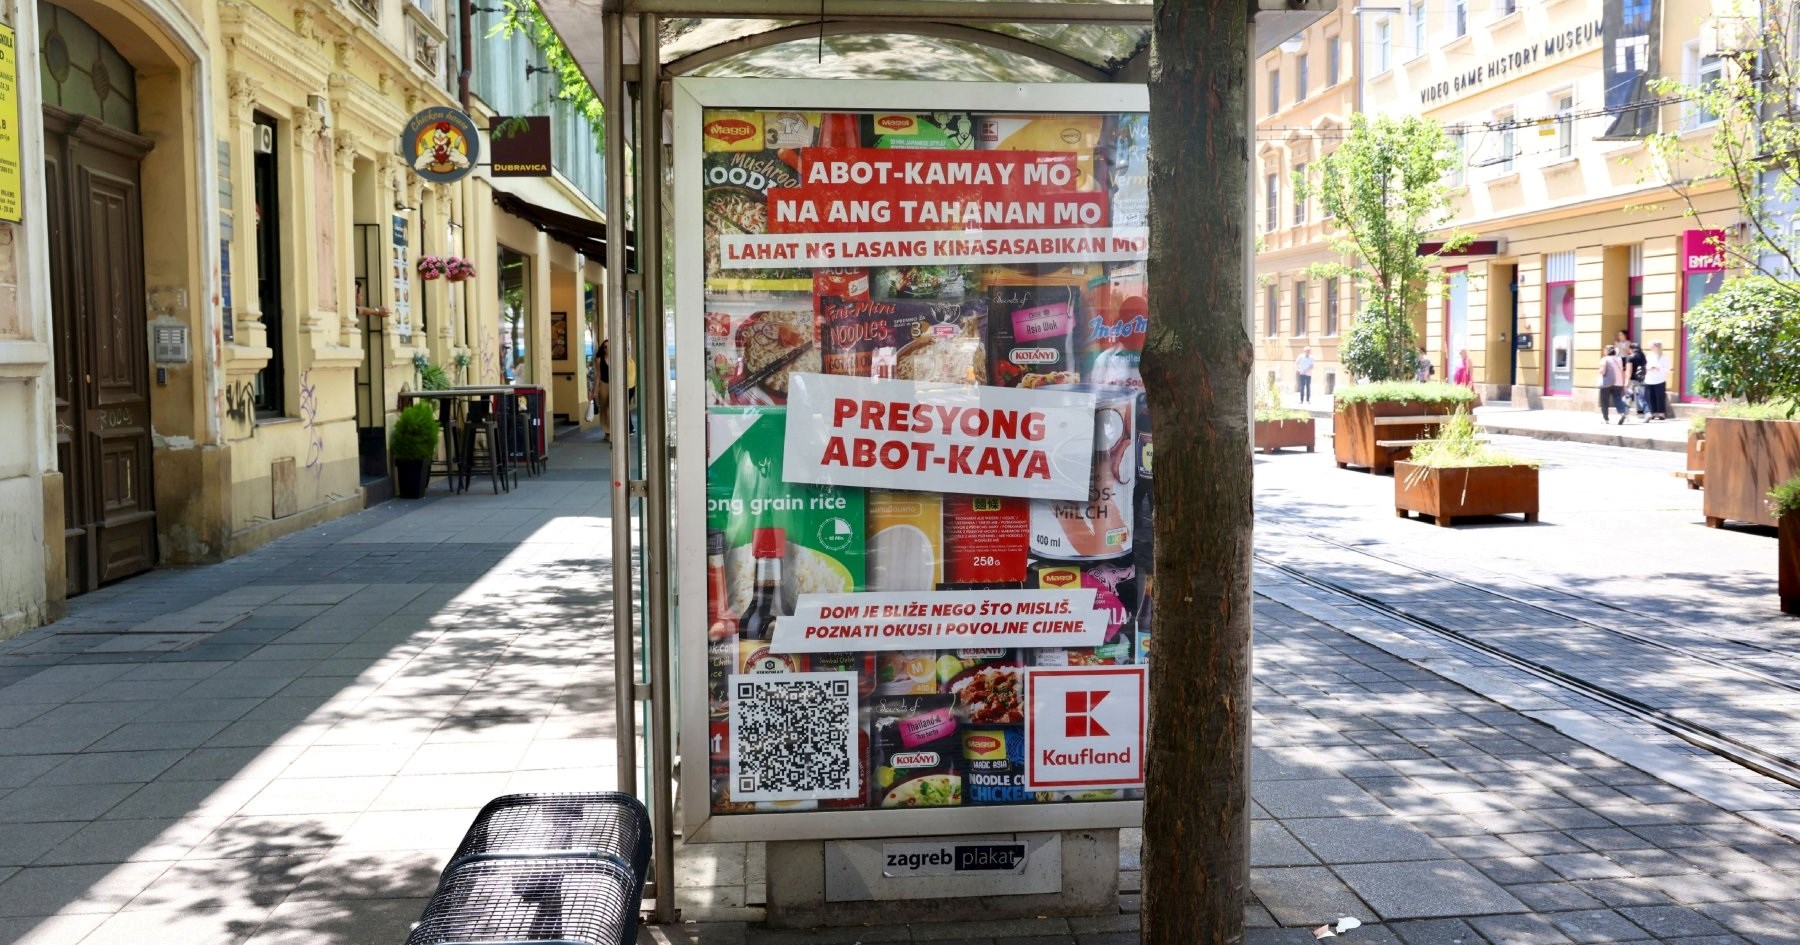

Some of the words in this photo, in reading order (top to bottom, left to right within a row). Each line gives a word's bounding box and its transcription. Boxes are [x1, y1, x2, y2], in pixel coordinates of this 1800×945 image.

[1421, 82, 1449, 104] VIDEO
[1454, 66, 1483, 92] GAME
[1488, 44, 1539, 79] HISTORY
[1545, 20, 1604, 57] MUSEUM
[411, 109, 444, 131] Chicken
[881, 118, 910, 127] Maggi
[710, 124, 751, 136] Maggi
[767, 128, 779, 145] 3
[494, 164, 547, 172] DUBRAVICA
[808, 161, 1015, 185] ABOT-KAMAY
[1024, 163, 1071, 186] MO
[704, 166, 778, 196] OOD
[777, 200, 819, 222] NA
[828, 200, 891, 223] ANG
[900, 201, 1045, 225] TAHANAN
[1054, 202, 1102, 225] MO
[728, 243, 799, 260] LAHAT
[806, 242, 836, 259] NG
[842, 240, 927, 258] LASANG
[933, 236, 1106, 257] KINASASABIKAN
[1113, 236, 1147, 253] MO
[911, 321, 922, 337] 3
[1026, 323, 1042, 335] Asia
[1043, 320, 1058, 332] Wok
[1015, 347, 1054, 360] KOTÁNYI
[833, 398, 1046, 441] PRESYONG
[821, 436, 1051, 480] ABOT-KAYA
[751, 494, 804, 515] grain
[810, 494, 847, 509] rice
[1055, 503, 1108, 520] MILCH
[1036, 534, 1049, 547] 400
[1050, 536, 1061, 548] ml
[1046, 573, 1073, 582] Maggi
[820, 605, 859, 619] DOM
[863, 605, 879, 618] JE
[883, 601, 928, 617] BLIŽE
[931, 602, 976, 616] NEGO
[980, 600, 1012, 616] ŠTO
[1016, 598, 1072, 615] MISLIŠ.
[805, 624, 879, 639] POZNATI
[883, 623, 931, 637] OKUSI
[936, 623, 942, 636] I
[945, 621, 1028, 635] POVOLJNE
[1032, 620, 1086, 634] CIJENE.
[911, 663, 923, 674] M
[907, 715, 935, 732] Thailand
[967, 740, 995, 749] Maggi
[896, 751, 935, 765] KOTÁNYI
[973, 761, 991, 769] MAGIC
[992, 760, 1007, 768] ASIA
[1043, 746, 1131, 766] Kaufland
[969, 773, 1010, 786] NOODLE
[887, 848, 953, 870] zagreb
[963, 847, 1015, 869] plakat
